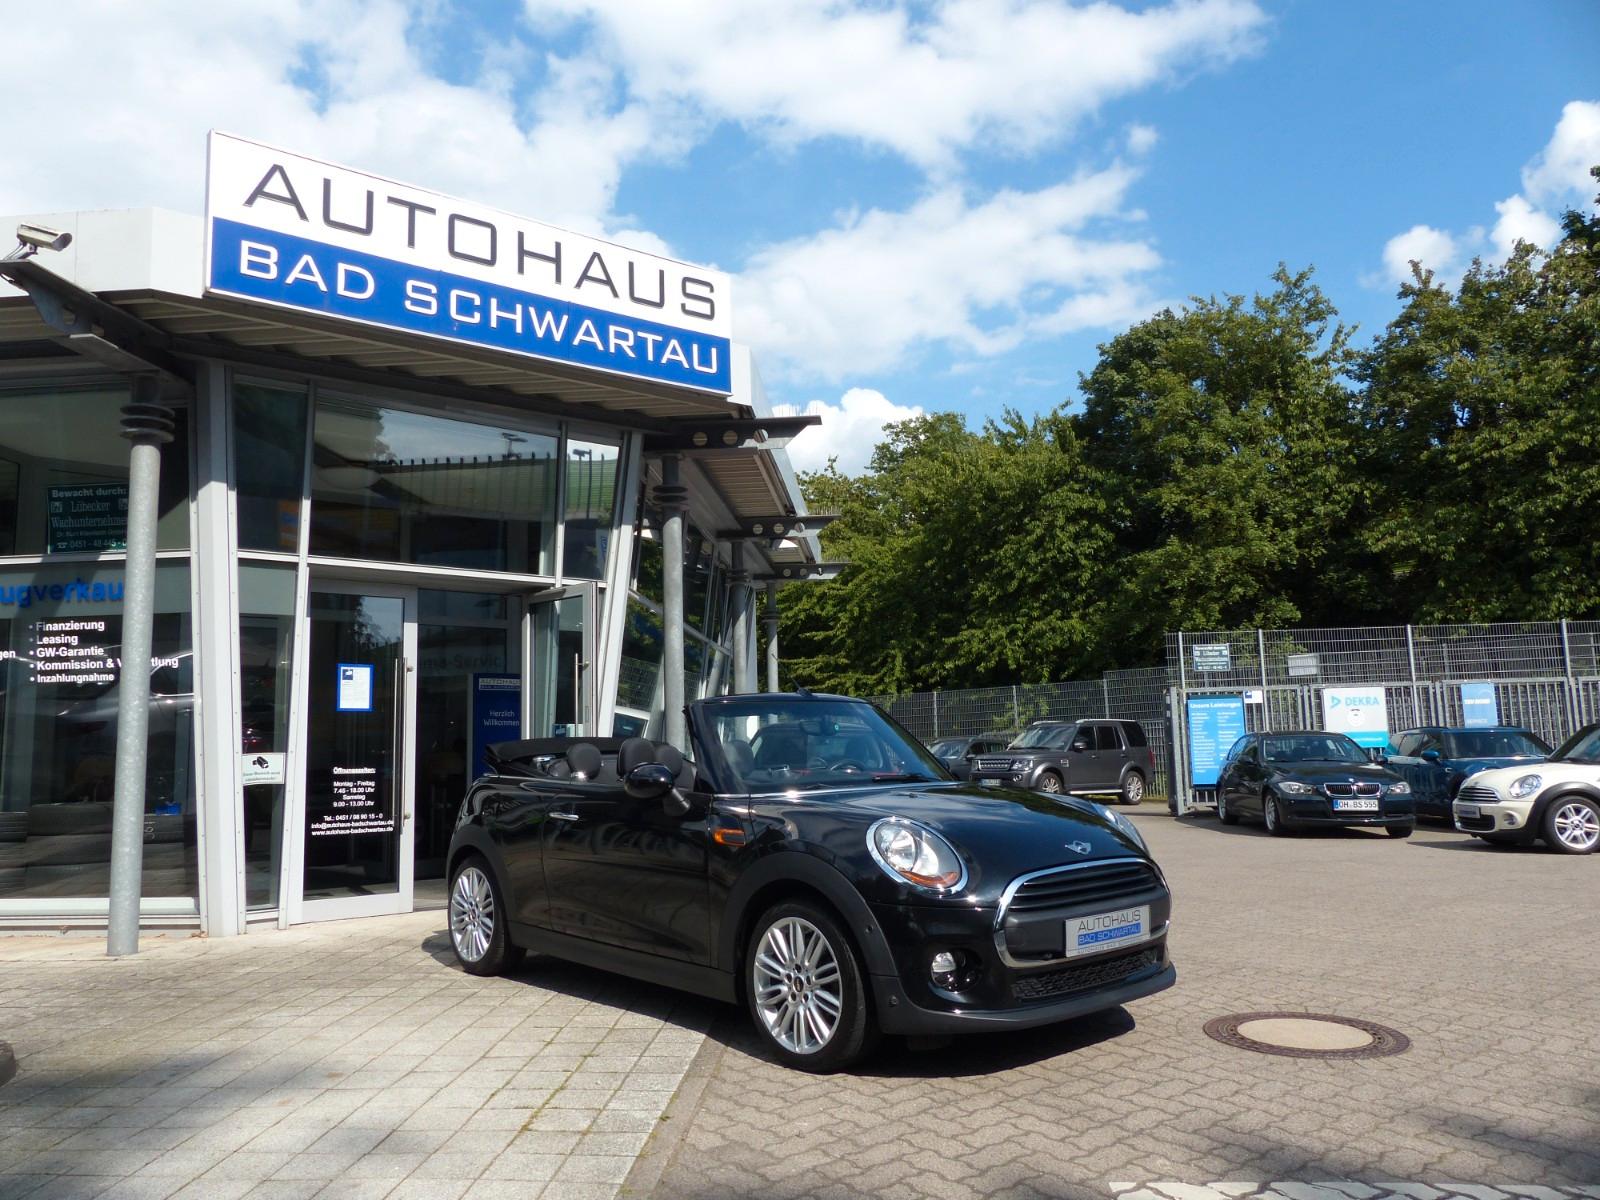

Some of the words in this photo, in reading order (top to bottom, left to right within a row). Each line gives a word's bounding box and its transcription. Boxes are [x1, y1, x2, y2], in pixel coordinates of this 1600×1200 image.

[242, 163, 716, 320] AUTOHAUS
[240, 239, 375, 300] BAD
[404, 279, 718, 374] SCHWARTAU
[52, 489, 94, 498] Bewacht
[95, 487, 127, 496] durch:
[71, 502, 111, 512] Lübecker
[36, 620, 105, 632] Finanzierung
[36, 634, 78, 645] Leasing
[36, 647, 104, 658] GW-Garantie
[36, 659, 103, 671] Kommission
[106, 659, 115, 669] &
[37, 673, 115, 684] Inzahlungnahme
[1345, 696, 1380, 706] DEKRA
[311, 826, 394, 836] www.autohaus-badschwartau.de
[1078, 909, 1141, 931] AUTOHAUS
[1079, 934, 1096, 944] BAD
[1098, 925, 1140, 939] SCHWARTAU
